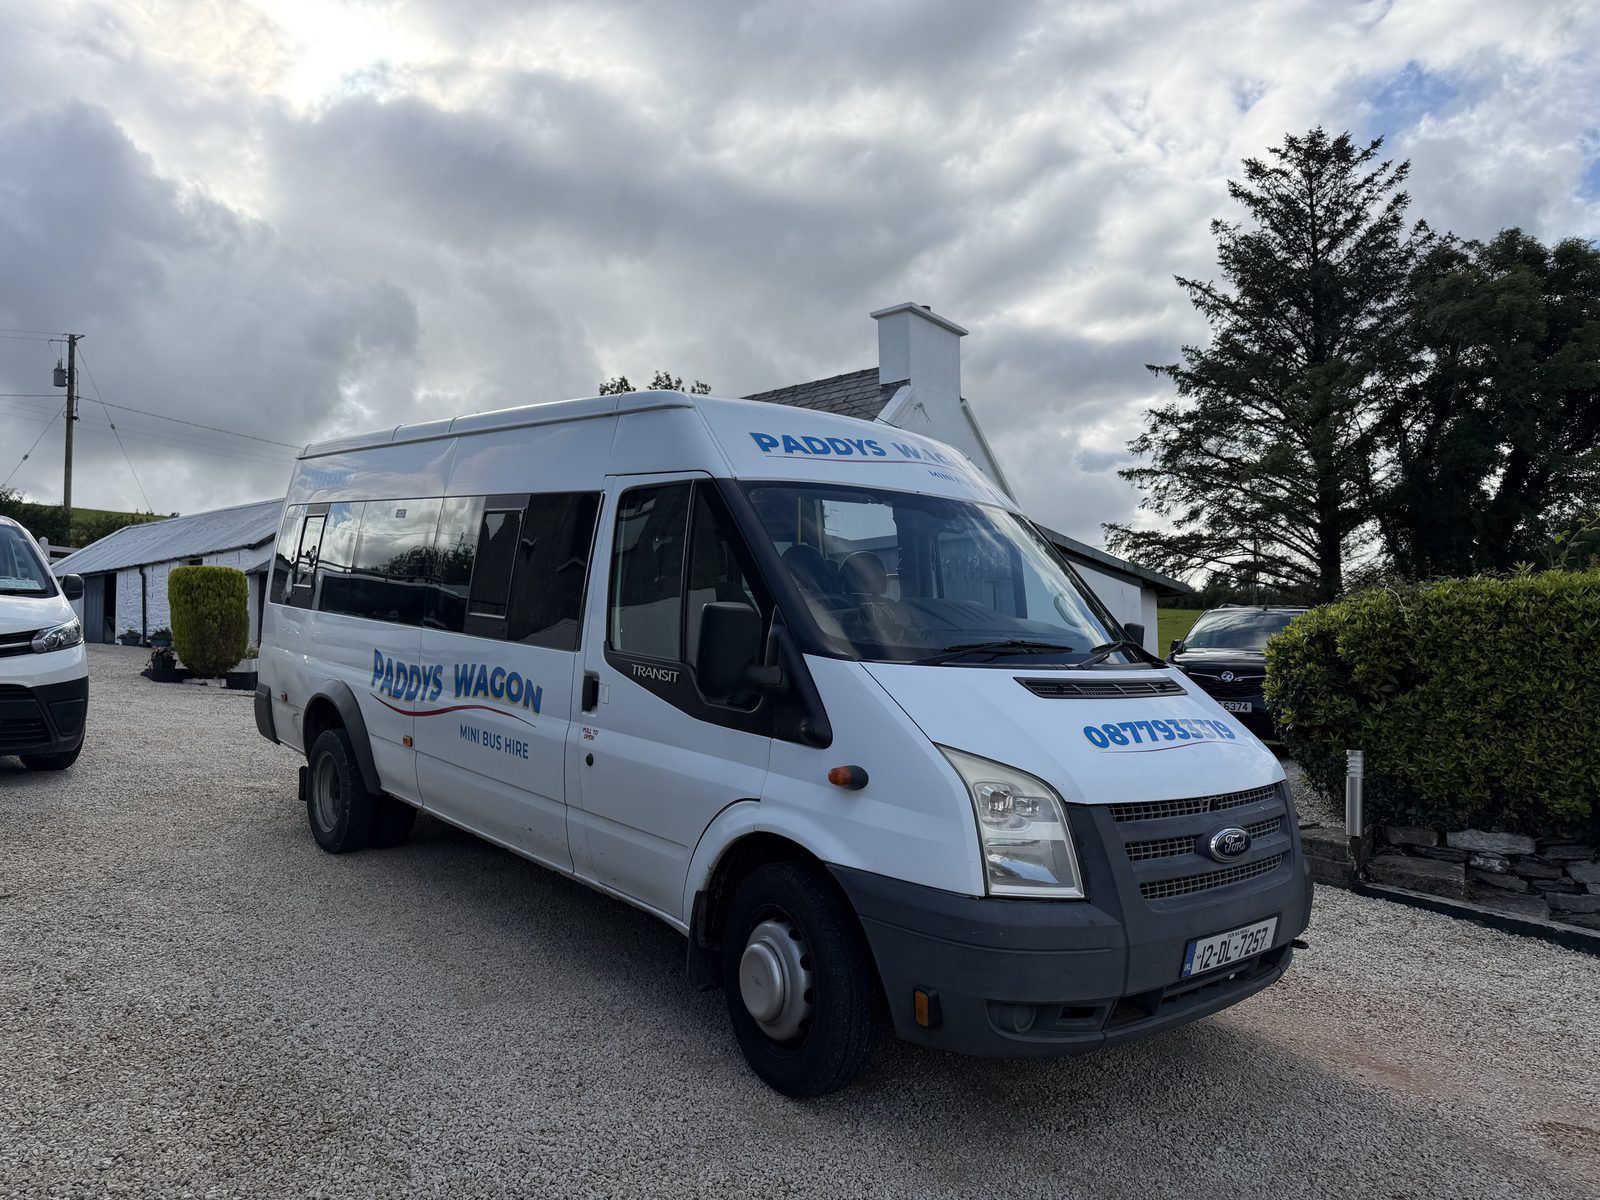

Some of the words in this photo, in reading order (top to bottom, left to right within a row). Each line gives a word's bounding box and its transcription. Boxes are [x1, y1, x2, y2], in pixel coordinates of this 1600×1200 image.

[750, 432, 886, 457] PADDYS
[891, 442, 952, 466] WAG
[371, 648, 443, 702] PADDYS
[453, 663, 543, 715] WAGON
[631, 664, 679, 683] TRANSIT
[1218, 702, 1249, 711] 6374
[460, 724, 480, 744] MINI
[482, 731, 501, 751] BUS
[505, 737, 529, 759] HIRE
[1083, 719, 1236, 748] 0877933319
[1224, 834, 1246, 853] Ford
[1199, 927, 1268, 970] 12-DL-7257
